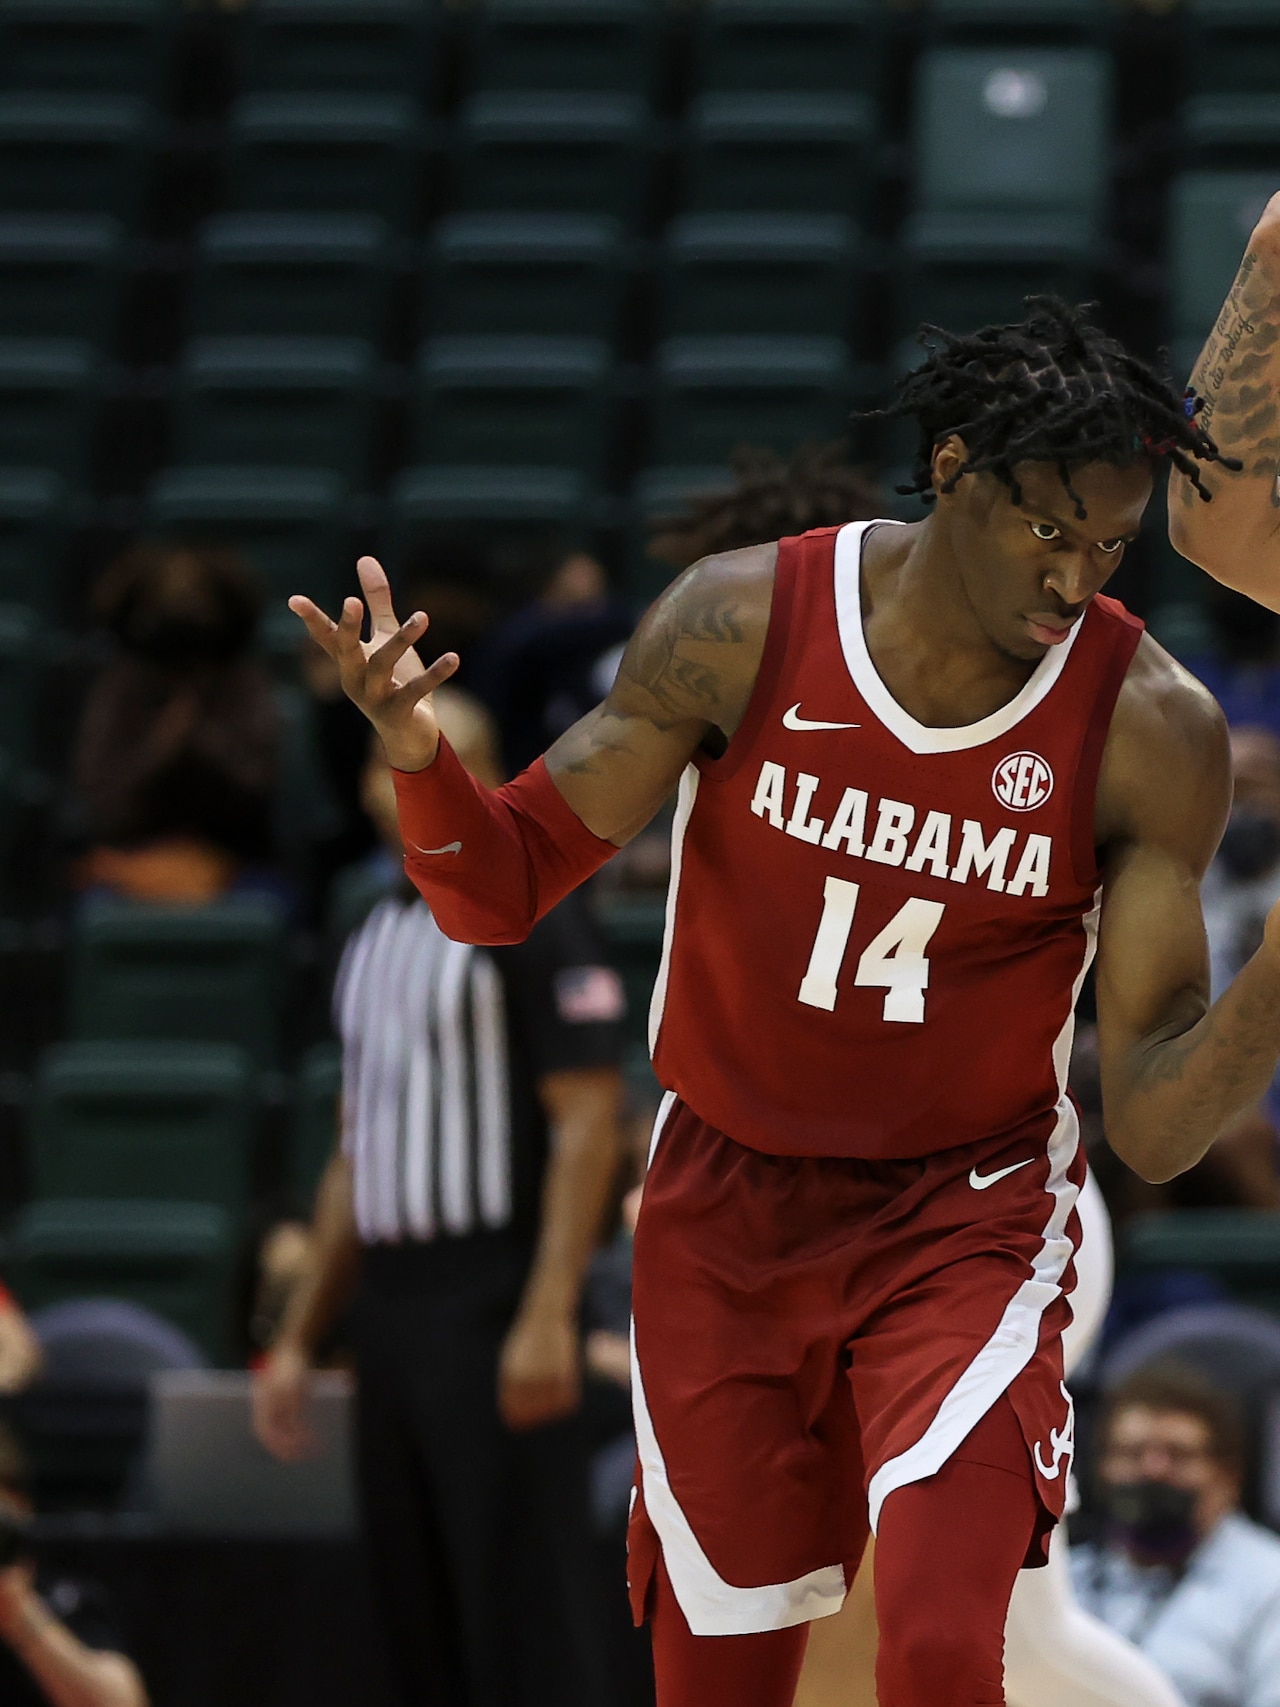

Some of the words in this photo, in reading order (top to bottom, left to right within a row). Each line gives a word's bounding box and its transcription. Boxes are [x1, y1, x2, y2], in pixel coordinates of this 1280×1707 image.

[750, 760, 1053, 898] ALABAMA
[996, 755, 1049, 808] SEC
[797, 875, 946, 1024] 14
